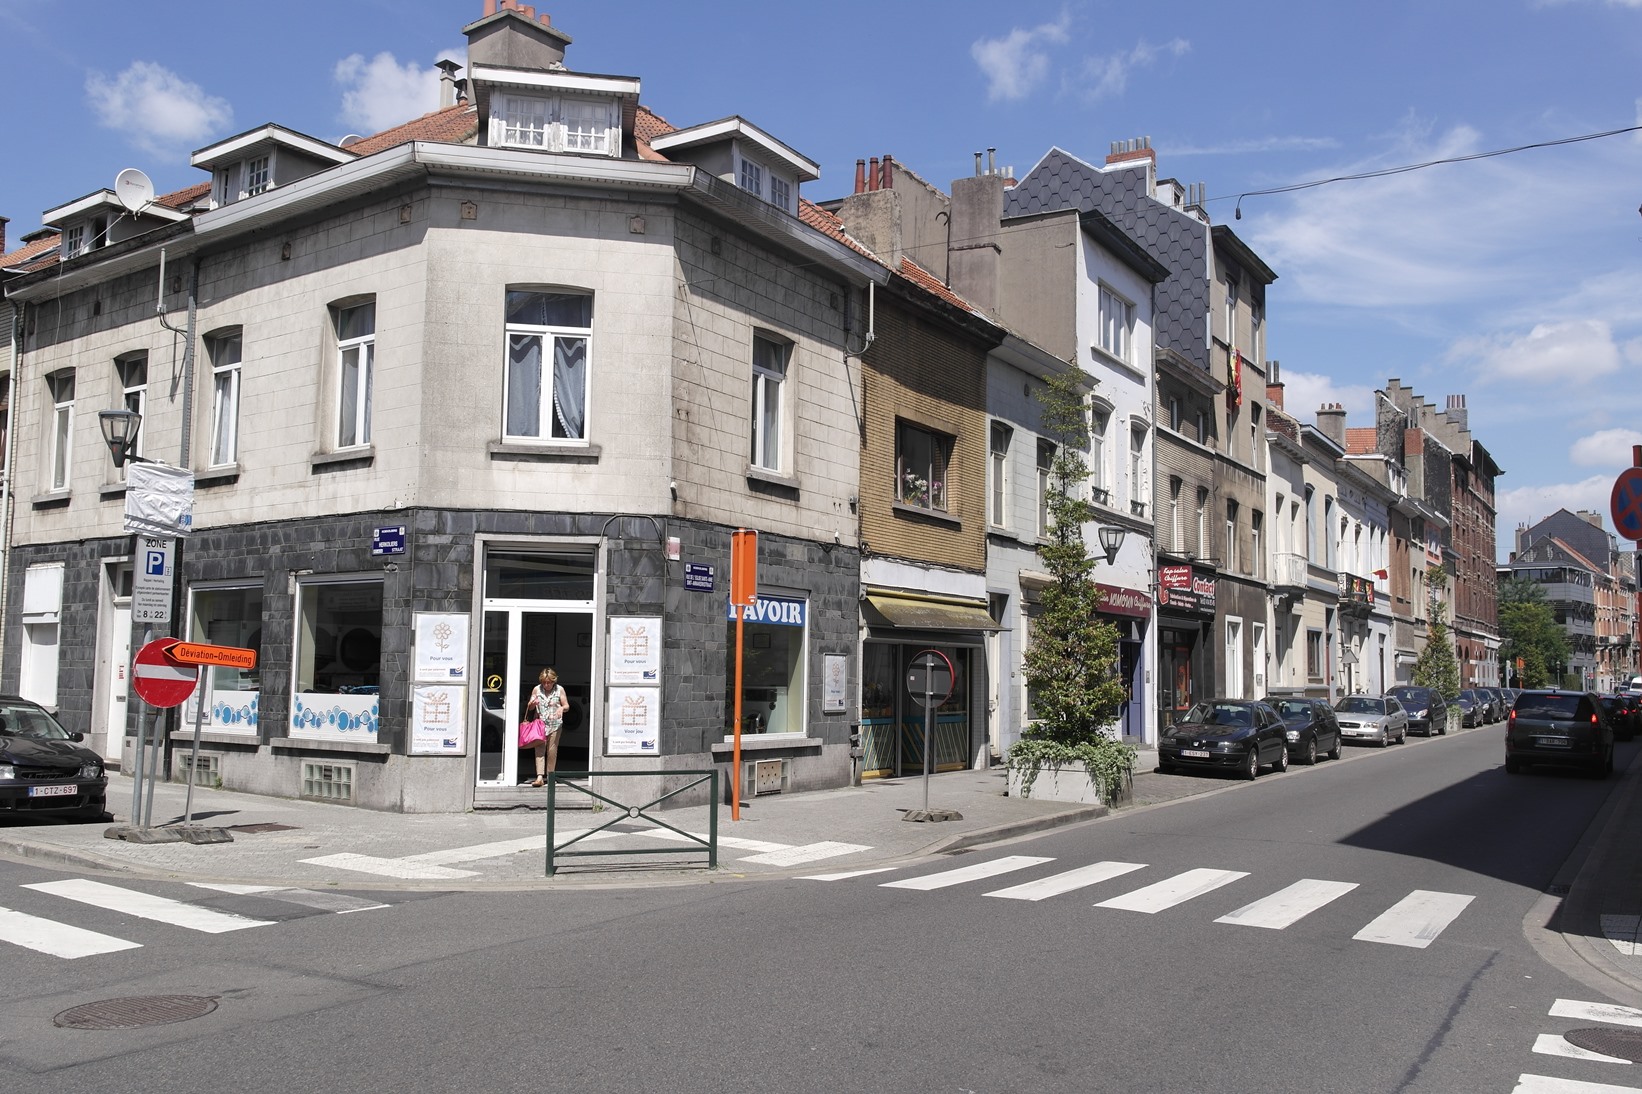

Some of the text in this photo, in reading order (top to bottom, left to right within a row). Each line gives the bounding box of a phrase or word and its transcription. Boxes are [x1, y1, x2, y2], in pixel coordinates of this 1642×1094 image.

[146, 538, 167, 549] ZONE
[148, 552, 163, 573] P
[1193, 577, 1215, 596] Contact
[143, 610, 148, 618] 8
[154, 611, 164, 619] 22
[180, 648, 252, 666] Déviation-Omleiding
[35, 785, 77, 795] 1-CTZ-697
